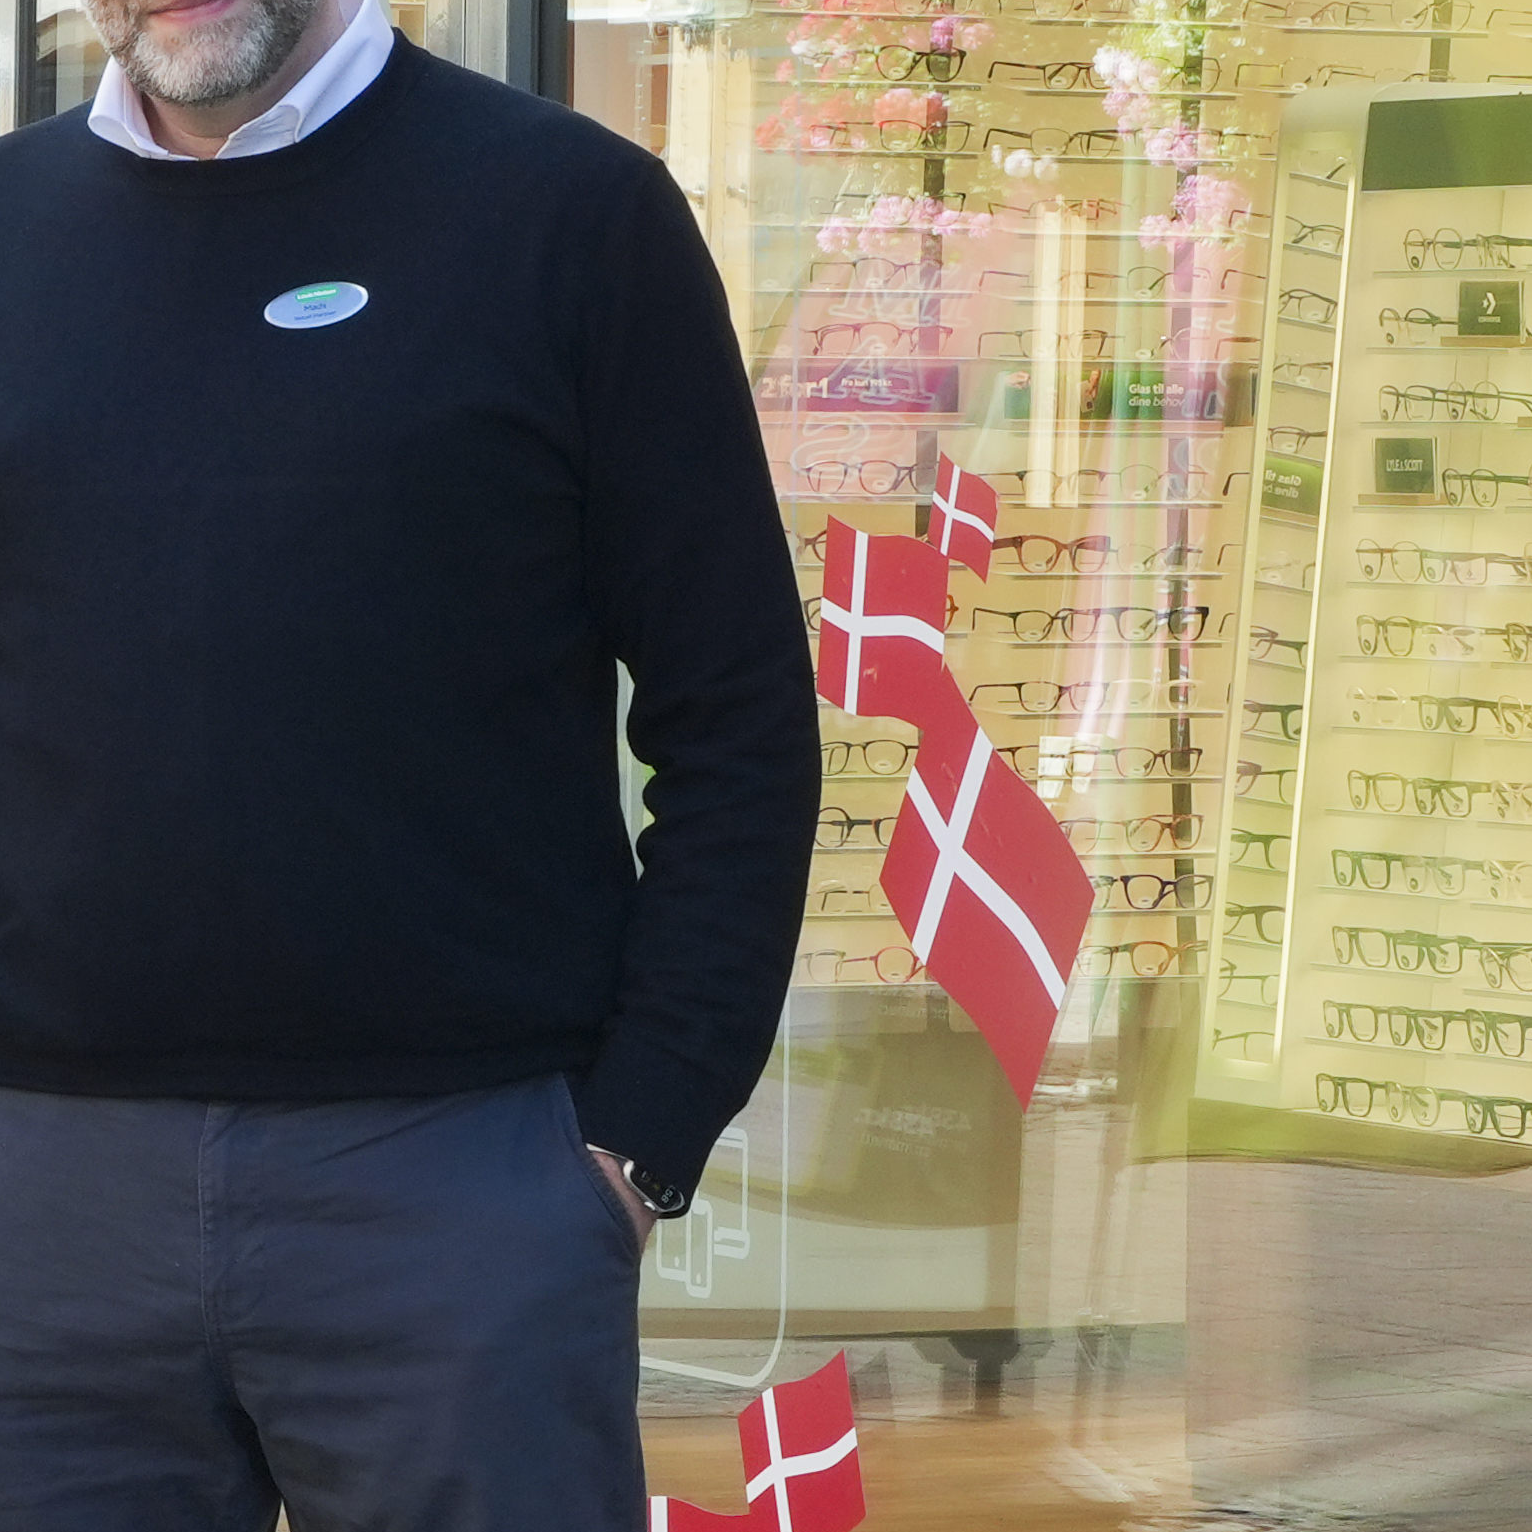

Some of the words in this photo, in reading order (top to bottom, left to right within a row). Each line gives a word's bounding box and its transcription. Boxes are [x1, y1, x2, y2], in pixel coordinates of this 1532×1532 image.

[1129, 383, 1152, 396] Glas
[1165, 384, 1184, 396] alle
[1129, 396, 1152, 408] dine
